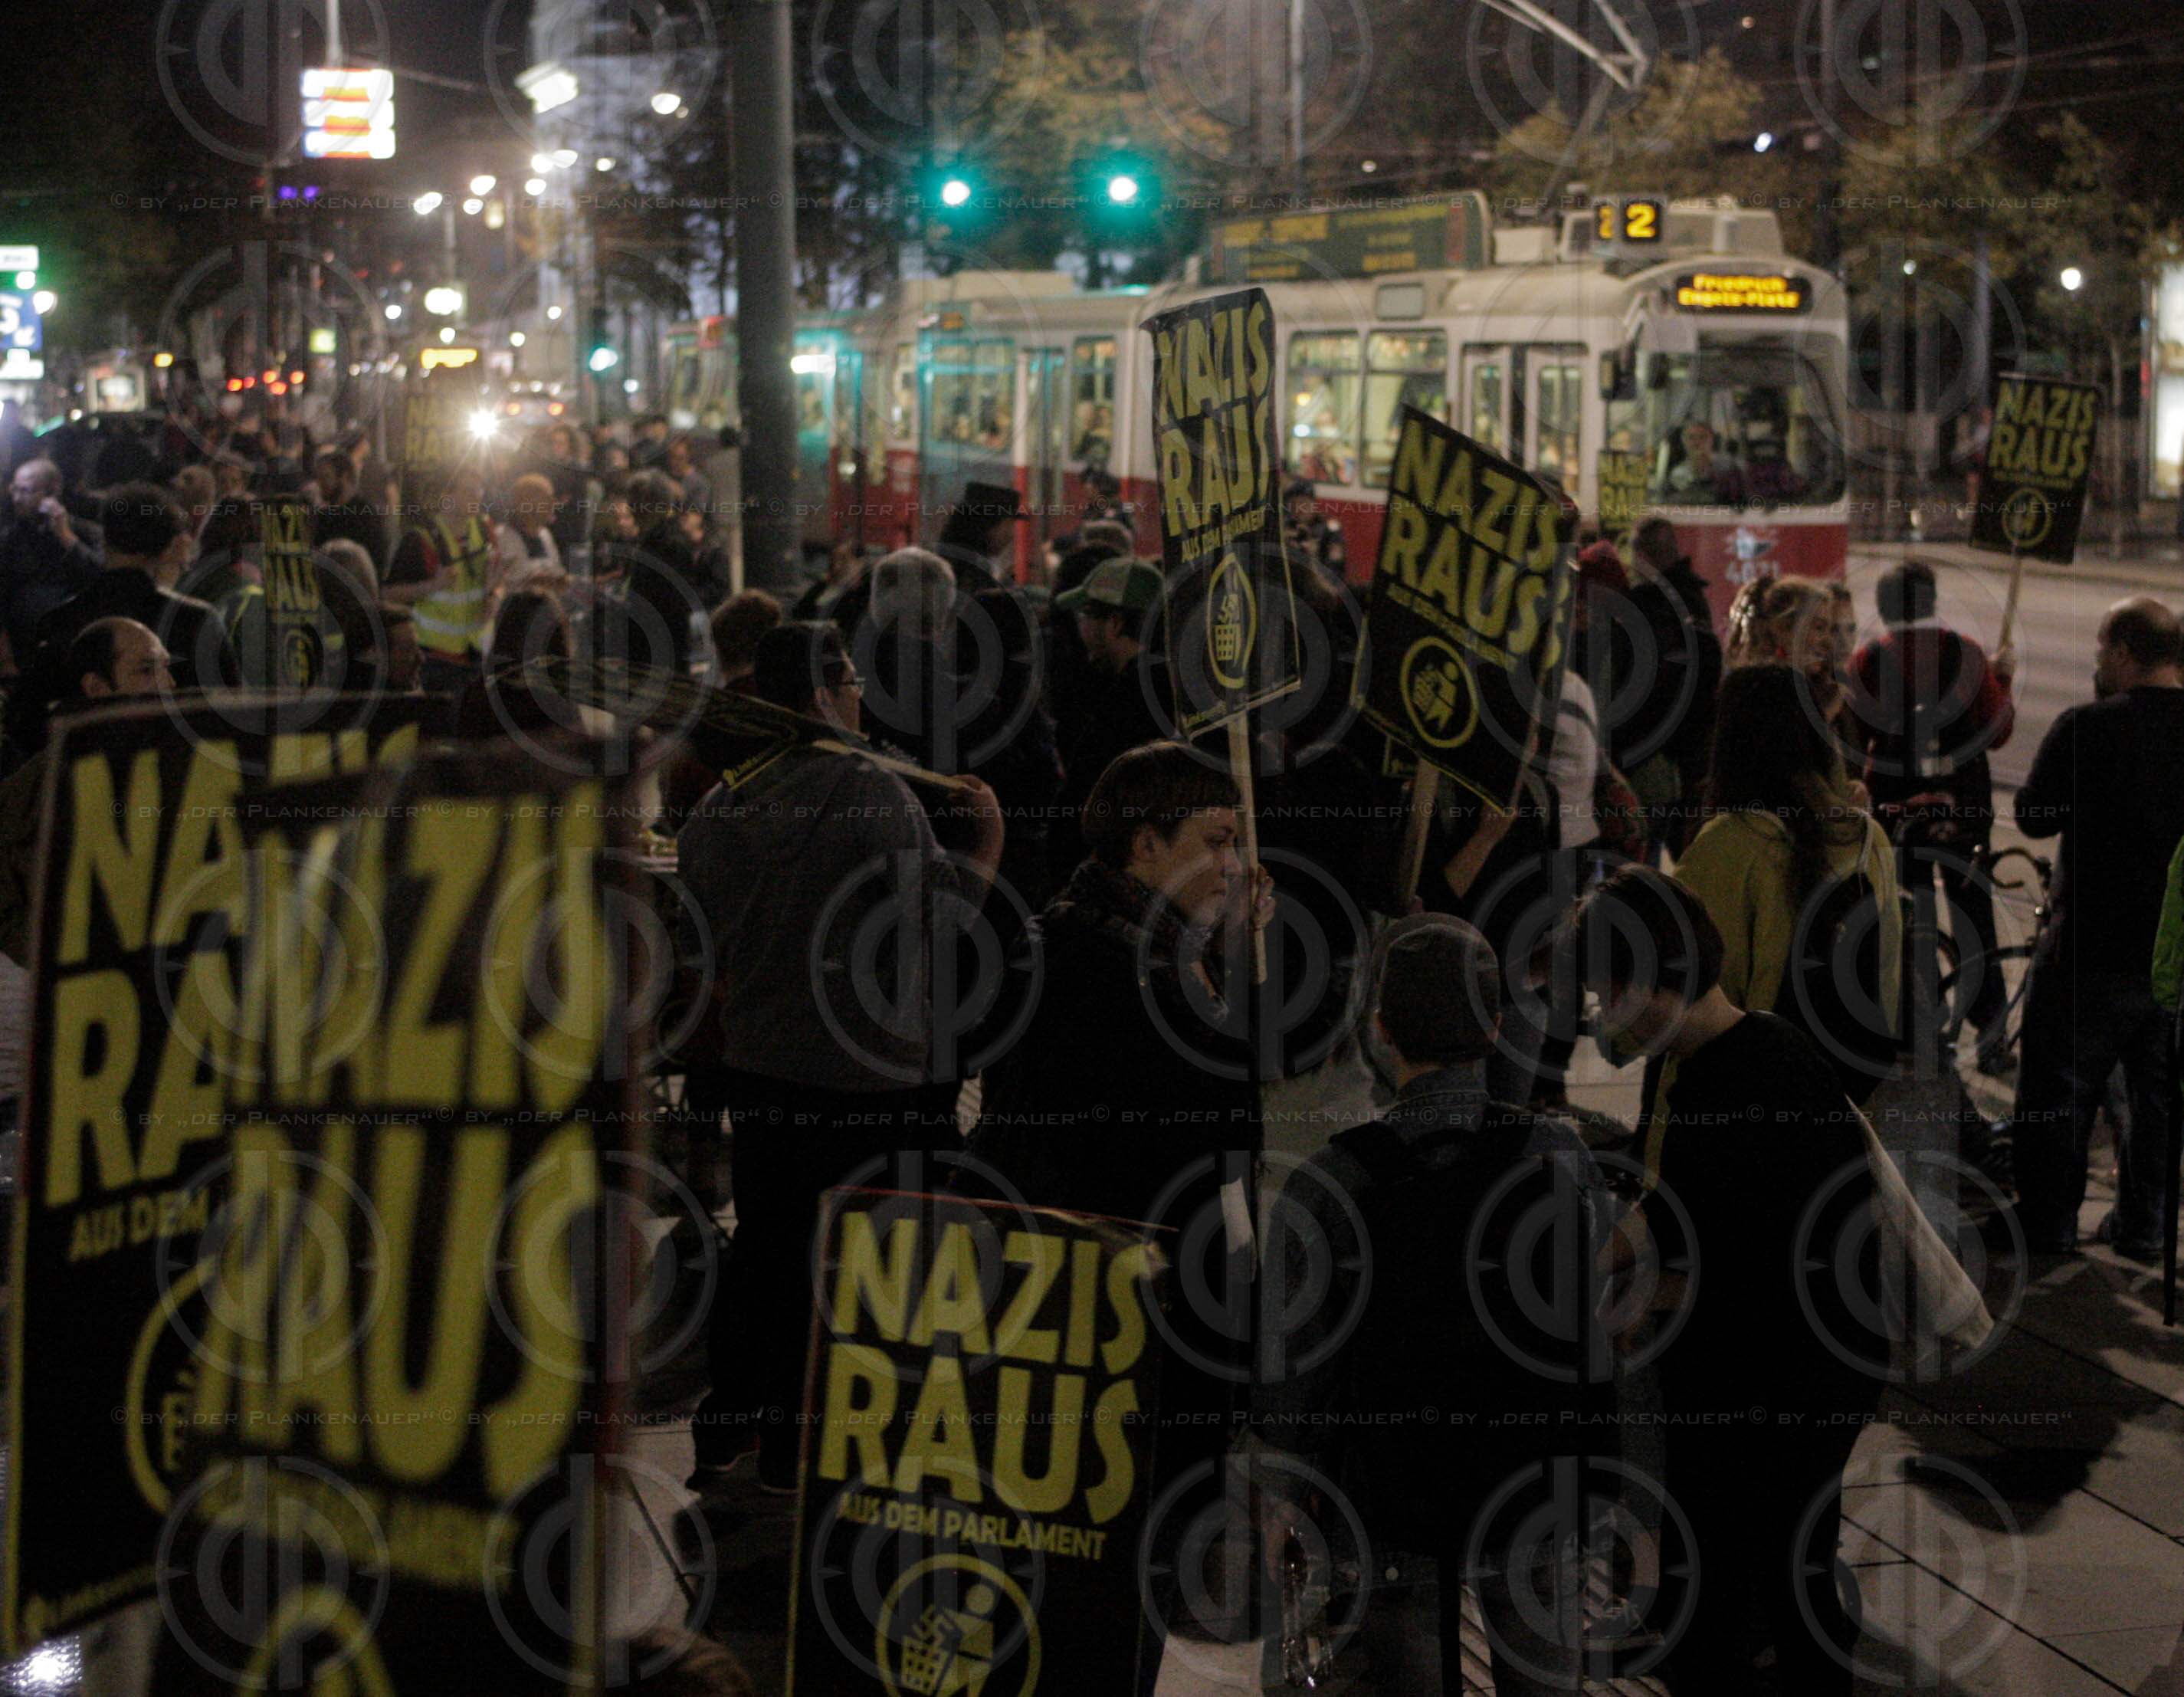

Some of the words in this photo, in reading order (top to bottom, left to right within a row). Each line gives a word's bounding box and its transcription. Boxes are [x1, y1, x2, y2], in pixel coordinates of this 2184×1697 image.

[1626, 203, 1655, 238] 2
[1157, 301, 1269, 427] NAZIS
[1994, 379, 2099, 433] NAZIS
[1160, 395, 1269, 537] RAUS
[1395, 419, 1561, 573] NAZIS
[1987, 421, 2091, 479] RAUS
[1380, 494, 1546, 655] RAUS
[828, 1210, 1161, 1377] NAZIS
[815, 1341, 1140, 1525] RAUS
[834, 1492, 883, 1525] AUS
[884, 1500, 940, 1538] DEM
[943, 1508, 1109, 1561] PARLAMENT
